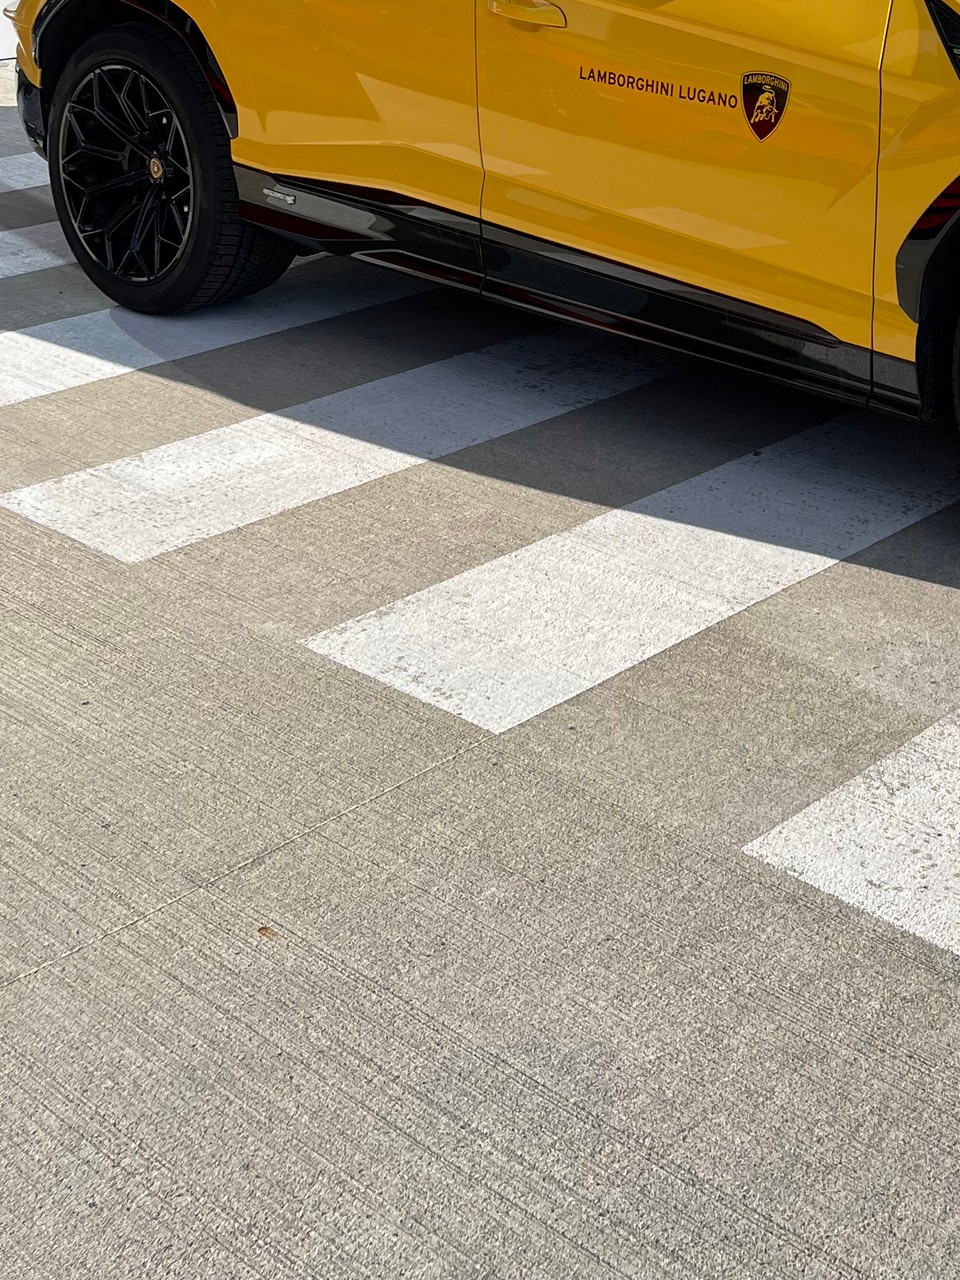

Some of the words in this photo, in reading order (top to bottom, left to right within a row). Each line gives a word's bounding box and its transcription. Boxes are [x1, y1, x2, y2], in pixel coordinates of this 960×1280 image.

[579, 66, 674, 97] LAMBORGHINI
[678, 85, 738, 109] LUGANO
[744, 75, 788, 92] LAMBORGHINI
